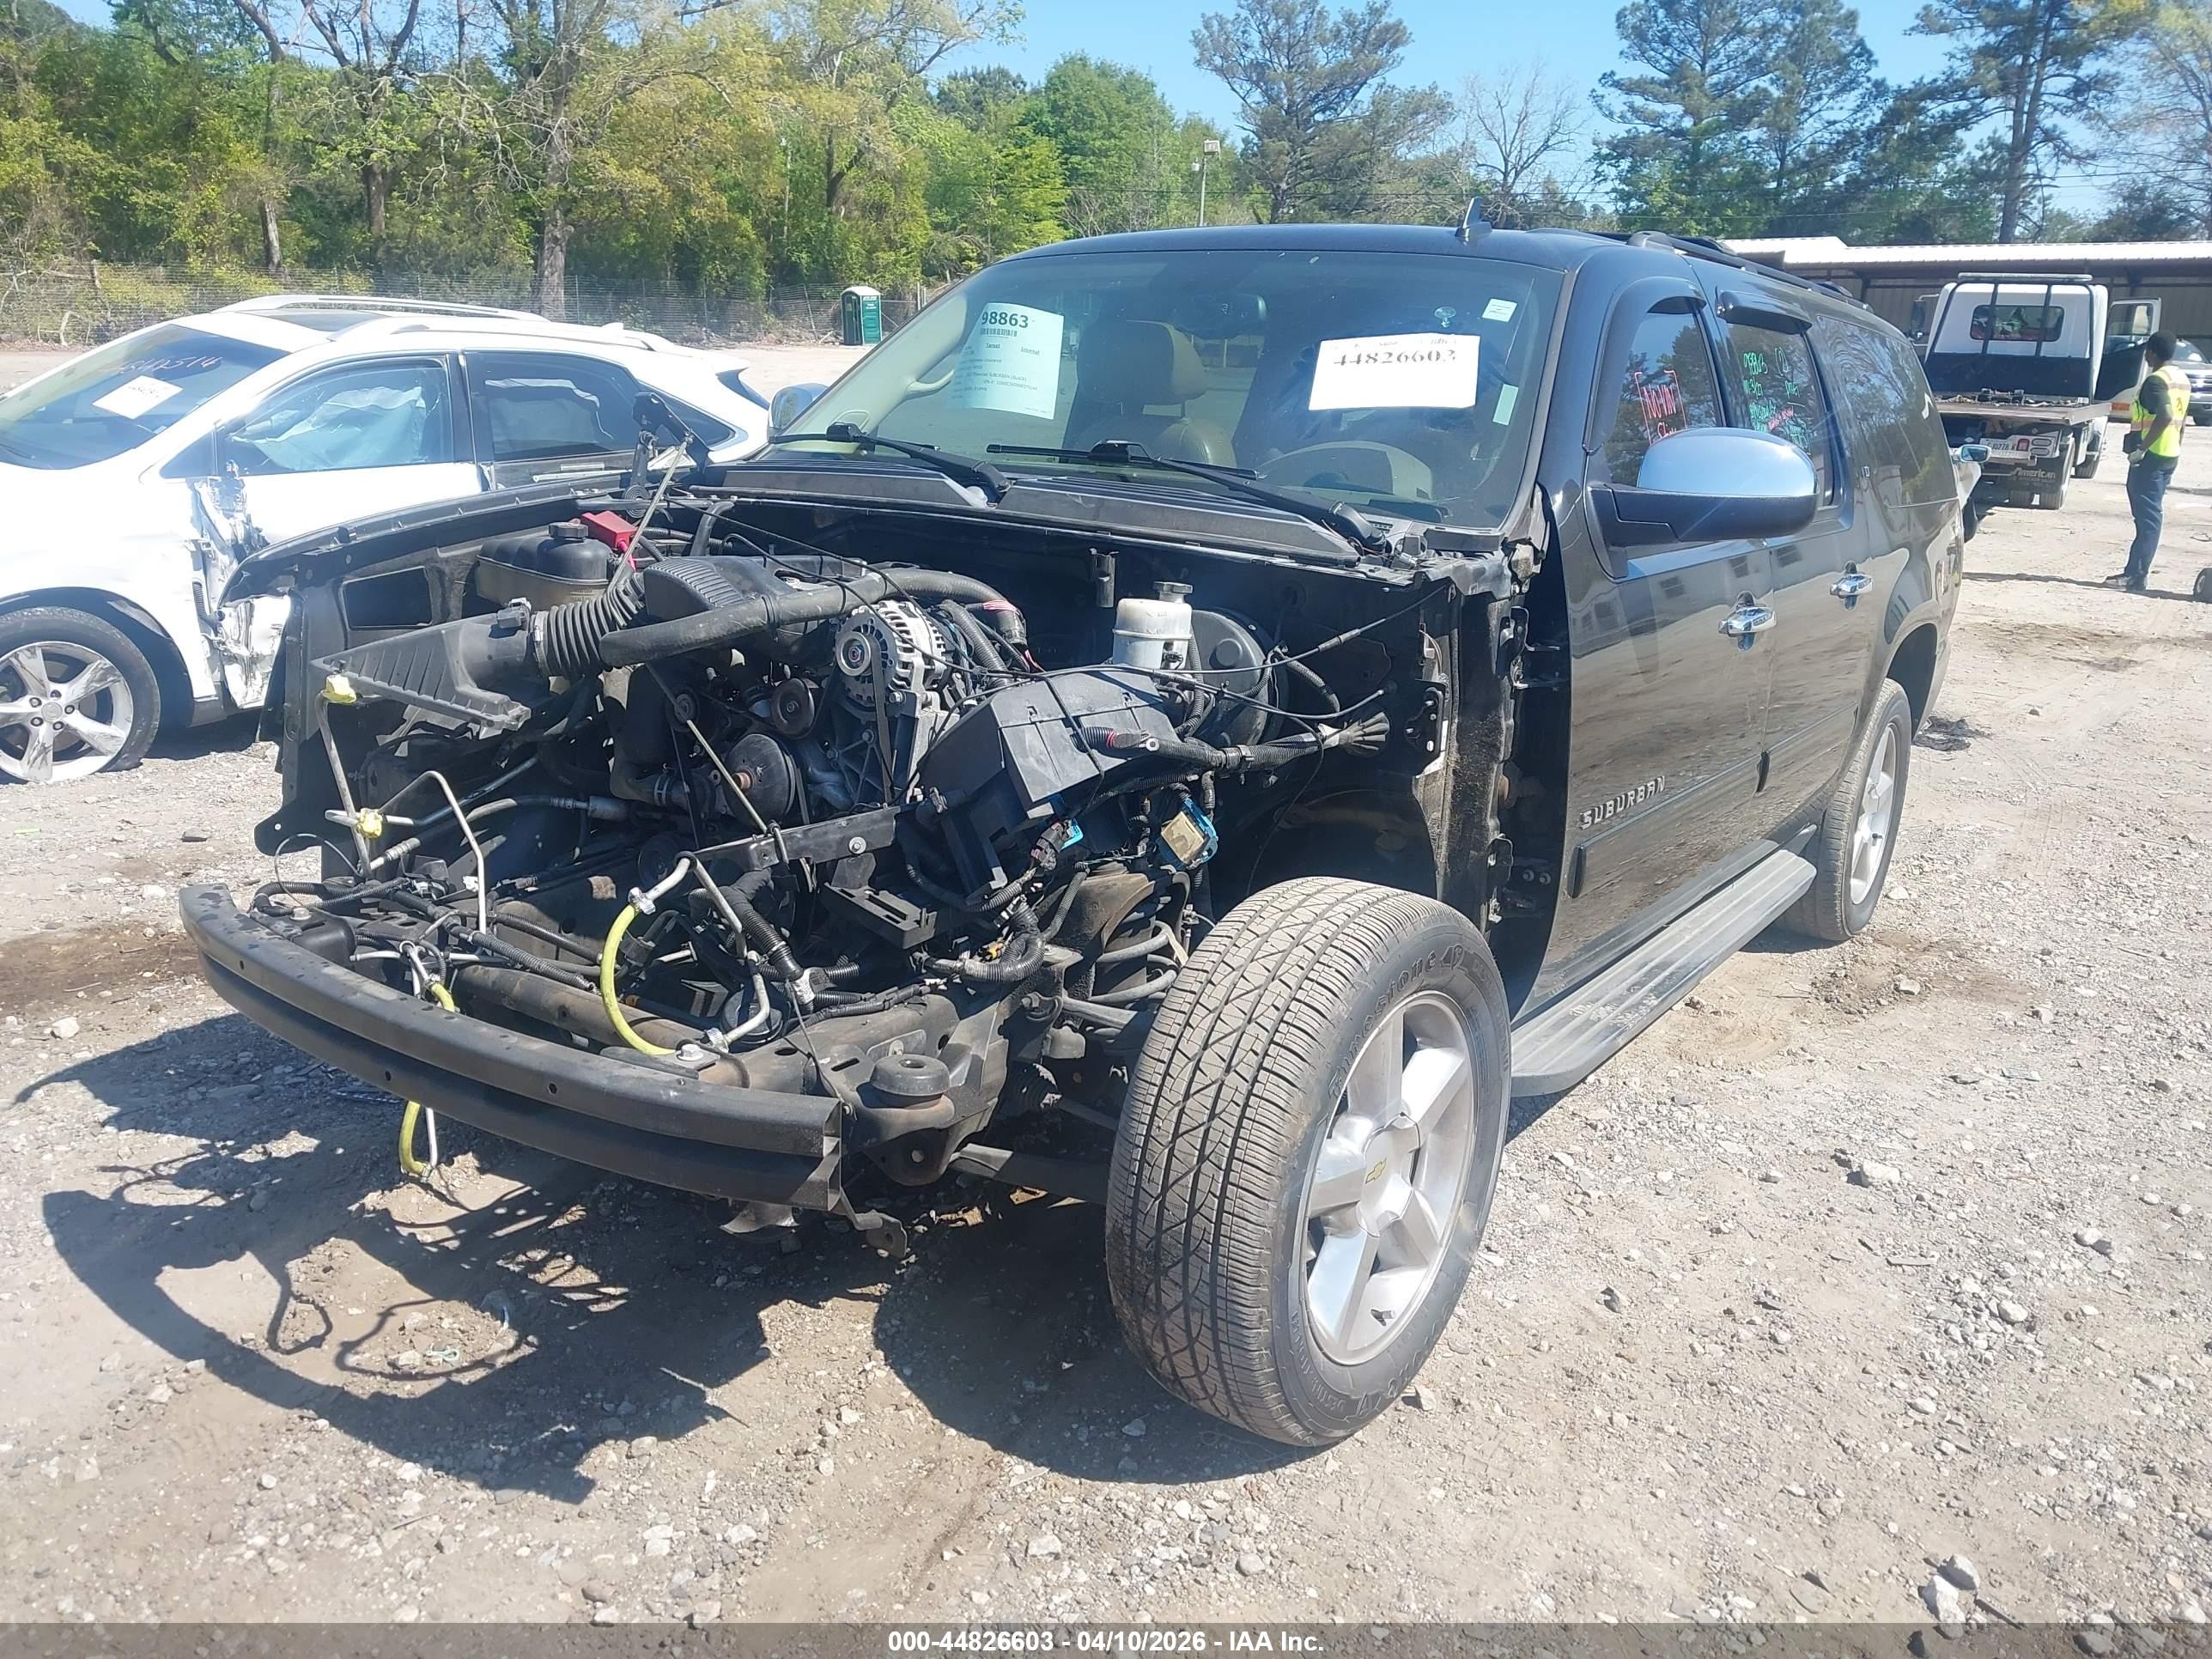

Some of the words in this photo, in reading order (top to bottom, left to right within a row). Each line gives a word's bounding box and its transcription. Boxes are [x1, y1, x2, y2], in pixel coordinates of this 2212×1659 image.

[981, 311, 1029, 328] 98863
[1334, 349, 1456, 366] 44826603
[1580, 775, 1665, 830] SUBURBAN
